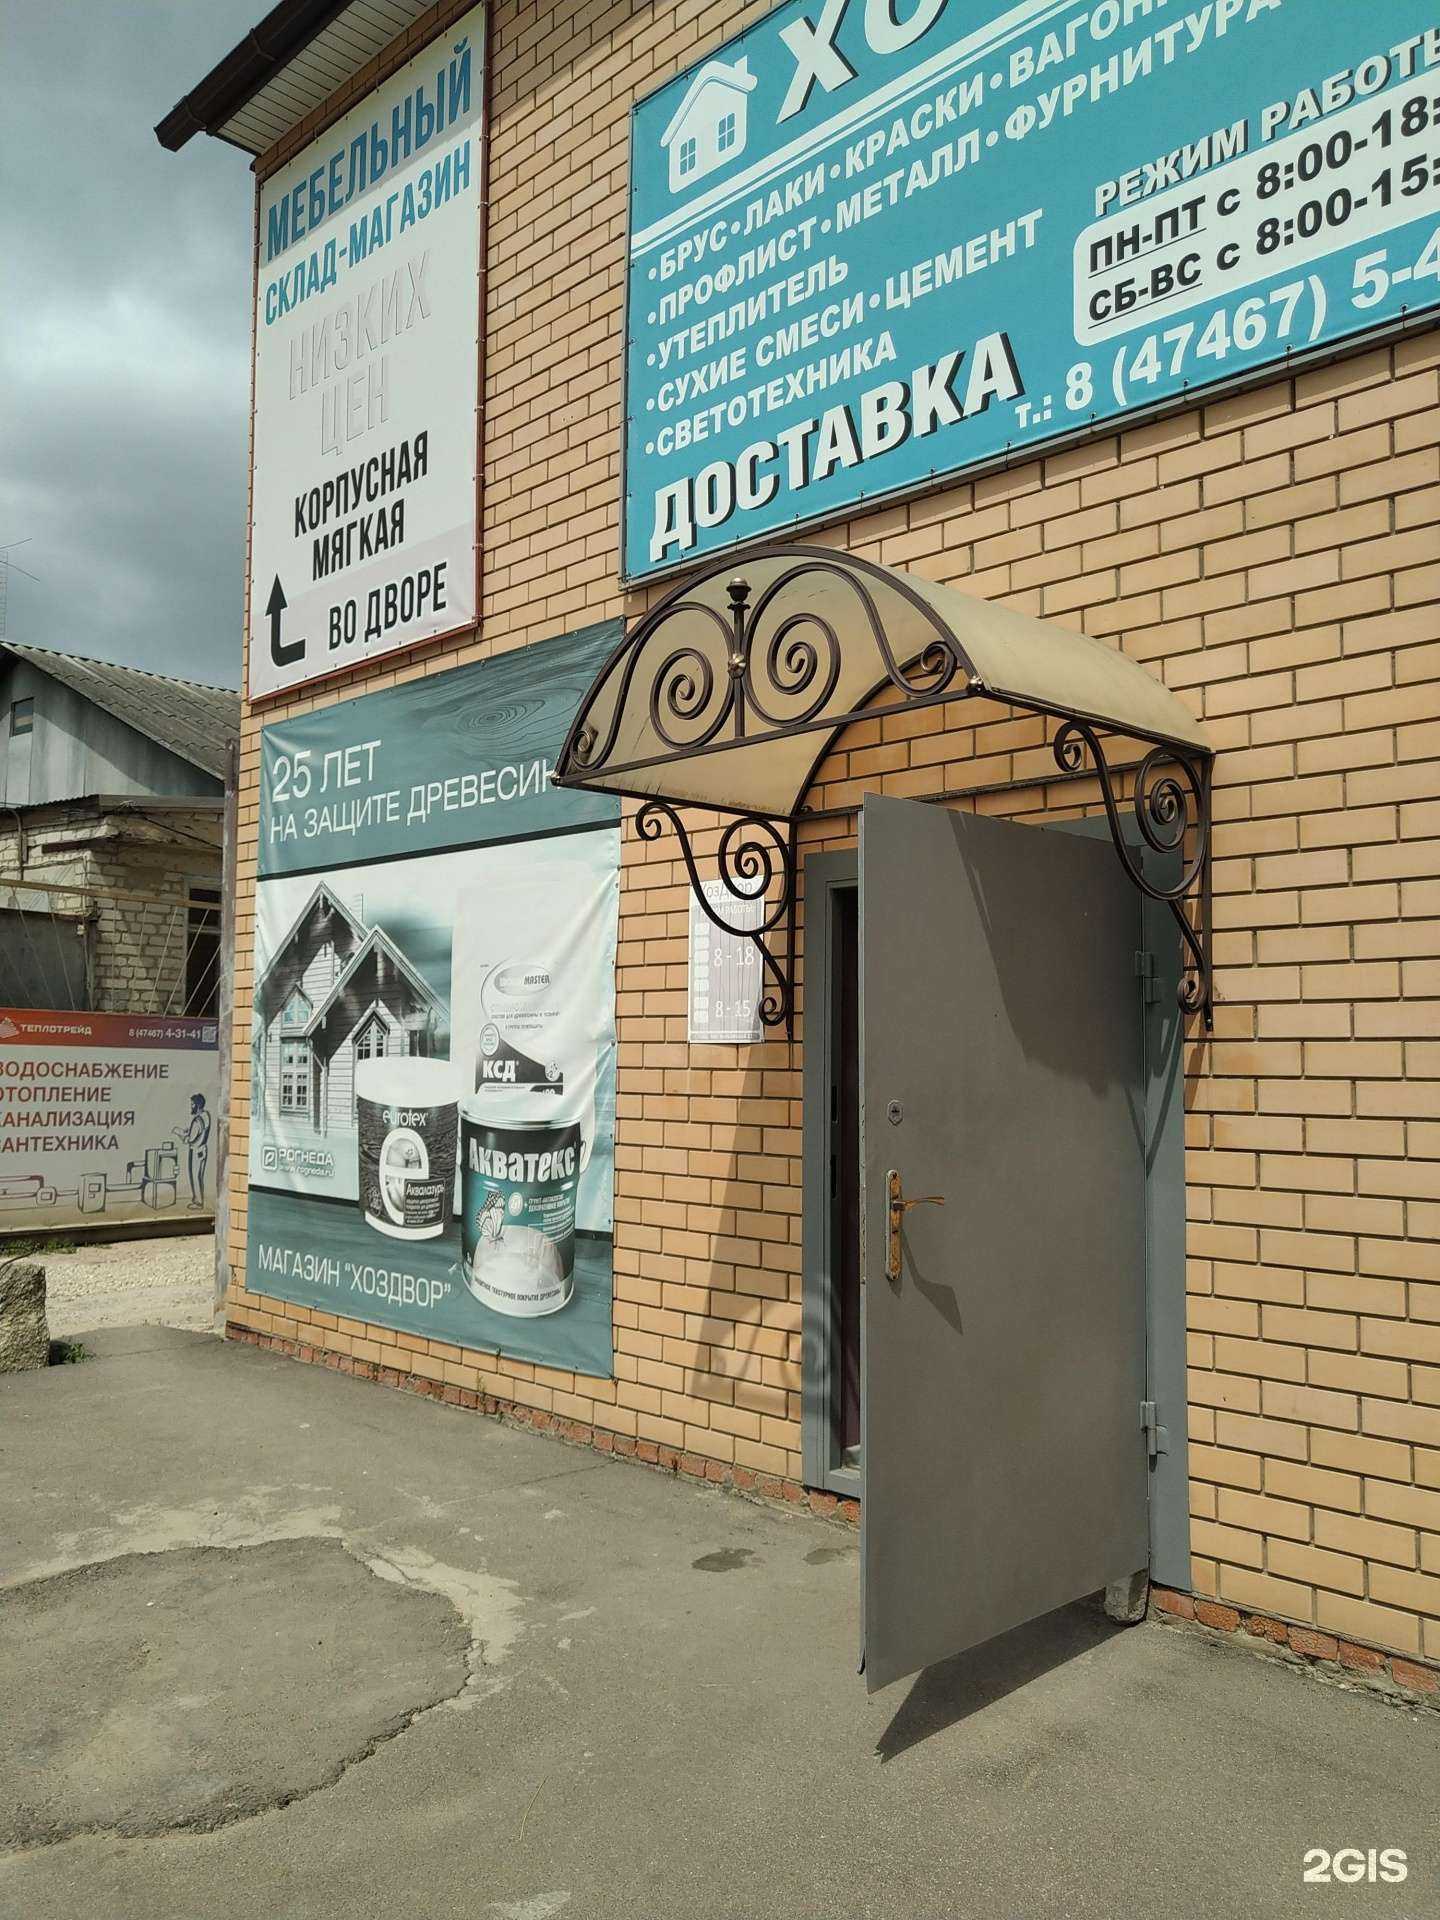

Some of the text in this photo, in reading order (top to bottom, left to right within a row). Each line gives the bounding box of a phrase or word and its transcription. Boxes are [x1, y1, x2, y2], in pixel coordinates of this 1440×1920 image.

[267, 36, 472, 263] МЕБЕЛЬНЫЙ
[660, 0, 1168, 282] БРУС ЛАКИ КРАСКИ ВАГОН
[1095, 119, 1248, 218] РЕЖИМ
[265, 139, 471, 326] СКЛАД-МАГАЗИН
[659, 216, 818, 326] ПРОФЛИСТ
[836, 129, 980, 234] МЕТАЛЛ
[1090, 195, 1206, 273] ПН-ПТ
[289, 250, 432, 401] НИЗКИХ
[657, 207, 1043, 413] СУХИЕ СМЕСИ ЦЕМЕНТ
[658, 254, 849, 370] УТЕПЛИТЕЛЬ
[1088, 253, 1201, 322] СБ-ВС
[1065, 362, 1094, 411] 8
[1112, 274, 1327, 407] (47467)
[322, 357, 389, 456] ЦЕН
[656, 330, 897, 457] СВЕТОТЕХНИКА
[294, 430, 428, 539] КОРПУСНАЯ
[649, 331, 1027, 562] ДОСТАВКА
[312, 498, 404, 581] МЯГКАЯ
[329, 561, 447, 651] ВО ДВОРЕ
[269, 814, 298, 845] НА
[303, 791, 400, 838] ЗАЩИТЕ
[271, 739, 382, 803] 25 ЛЕТ
[713, 948, 723, 967] 8
[736, 946, 755, 966] 18
[20, 1023, 92, 1036] ТЕПЛОТРЕЙД
[482, 1060, 516, 1083] КСД
[0, 1110, 135, 1129] АНАЛИЗАЦИЯ
[0, 1134, 119, 1153] АНТЕХНИКА
[279, 1148, 334, 1166] РОГНЕДА
[258, 1244, 340, 1287] МАГАЗИН
